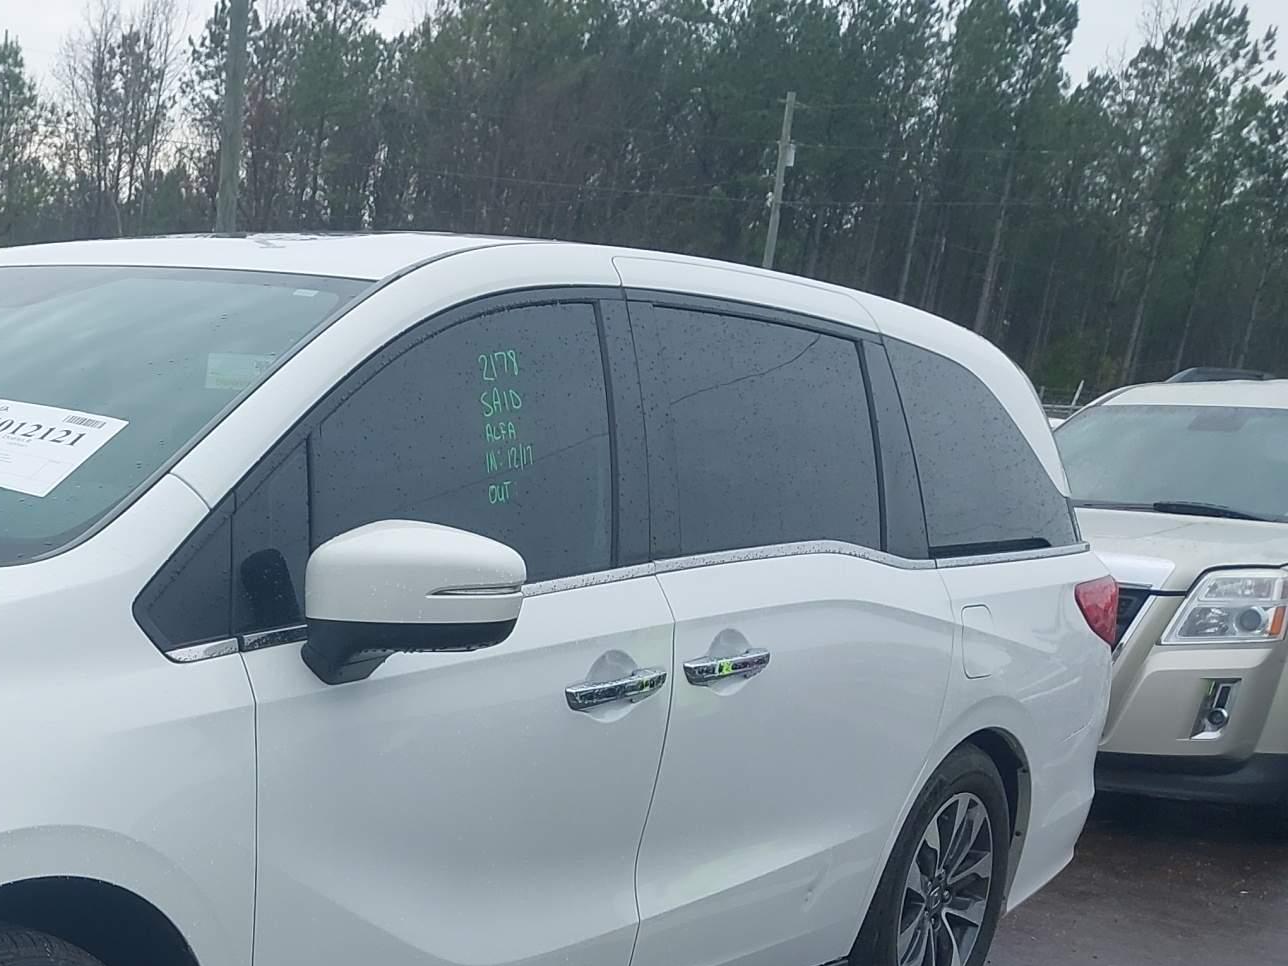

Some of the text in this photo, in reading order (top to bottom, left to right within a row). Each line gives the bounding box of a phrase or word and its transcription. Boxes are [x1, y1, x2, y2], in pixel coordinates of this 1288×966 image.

[480, 387, 522, 416] SAID
[485, 421, 516, 442] ALFA
[507, 443, 534, 471] 12/17
